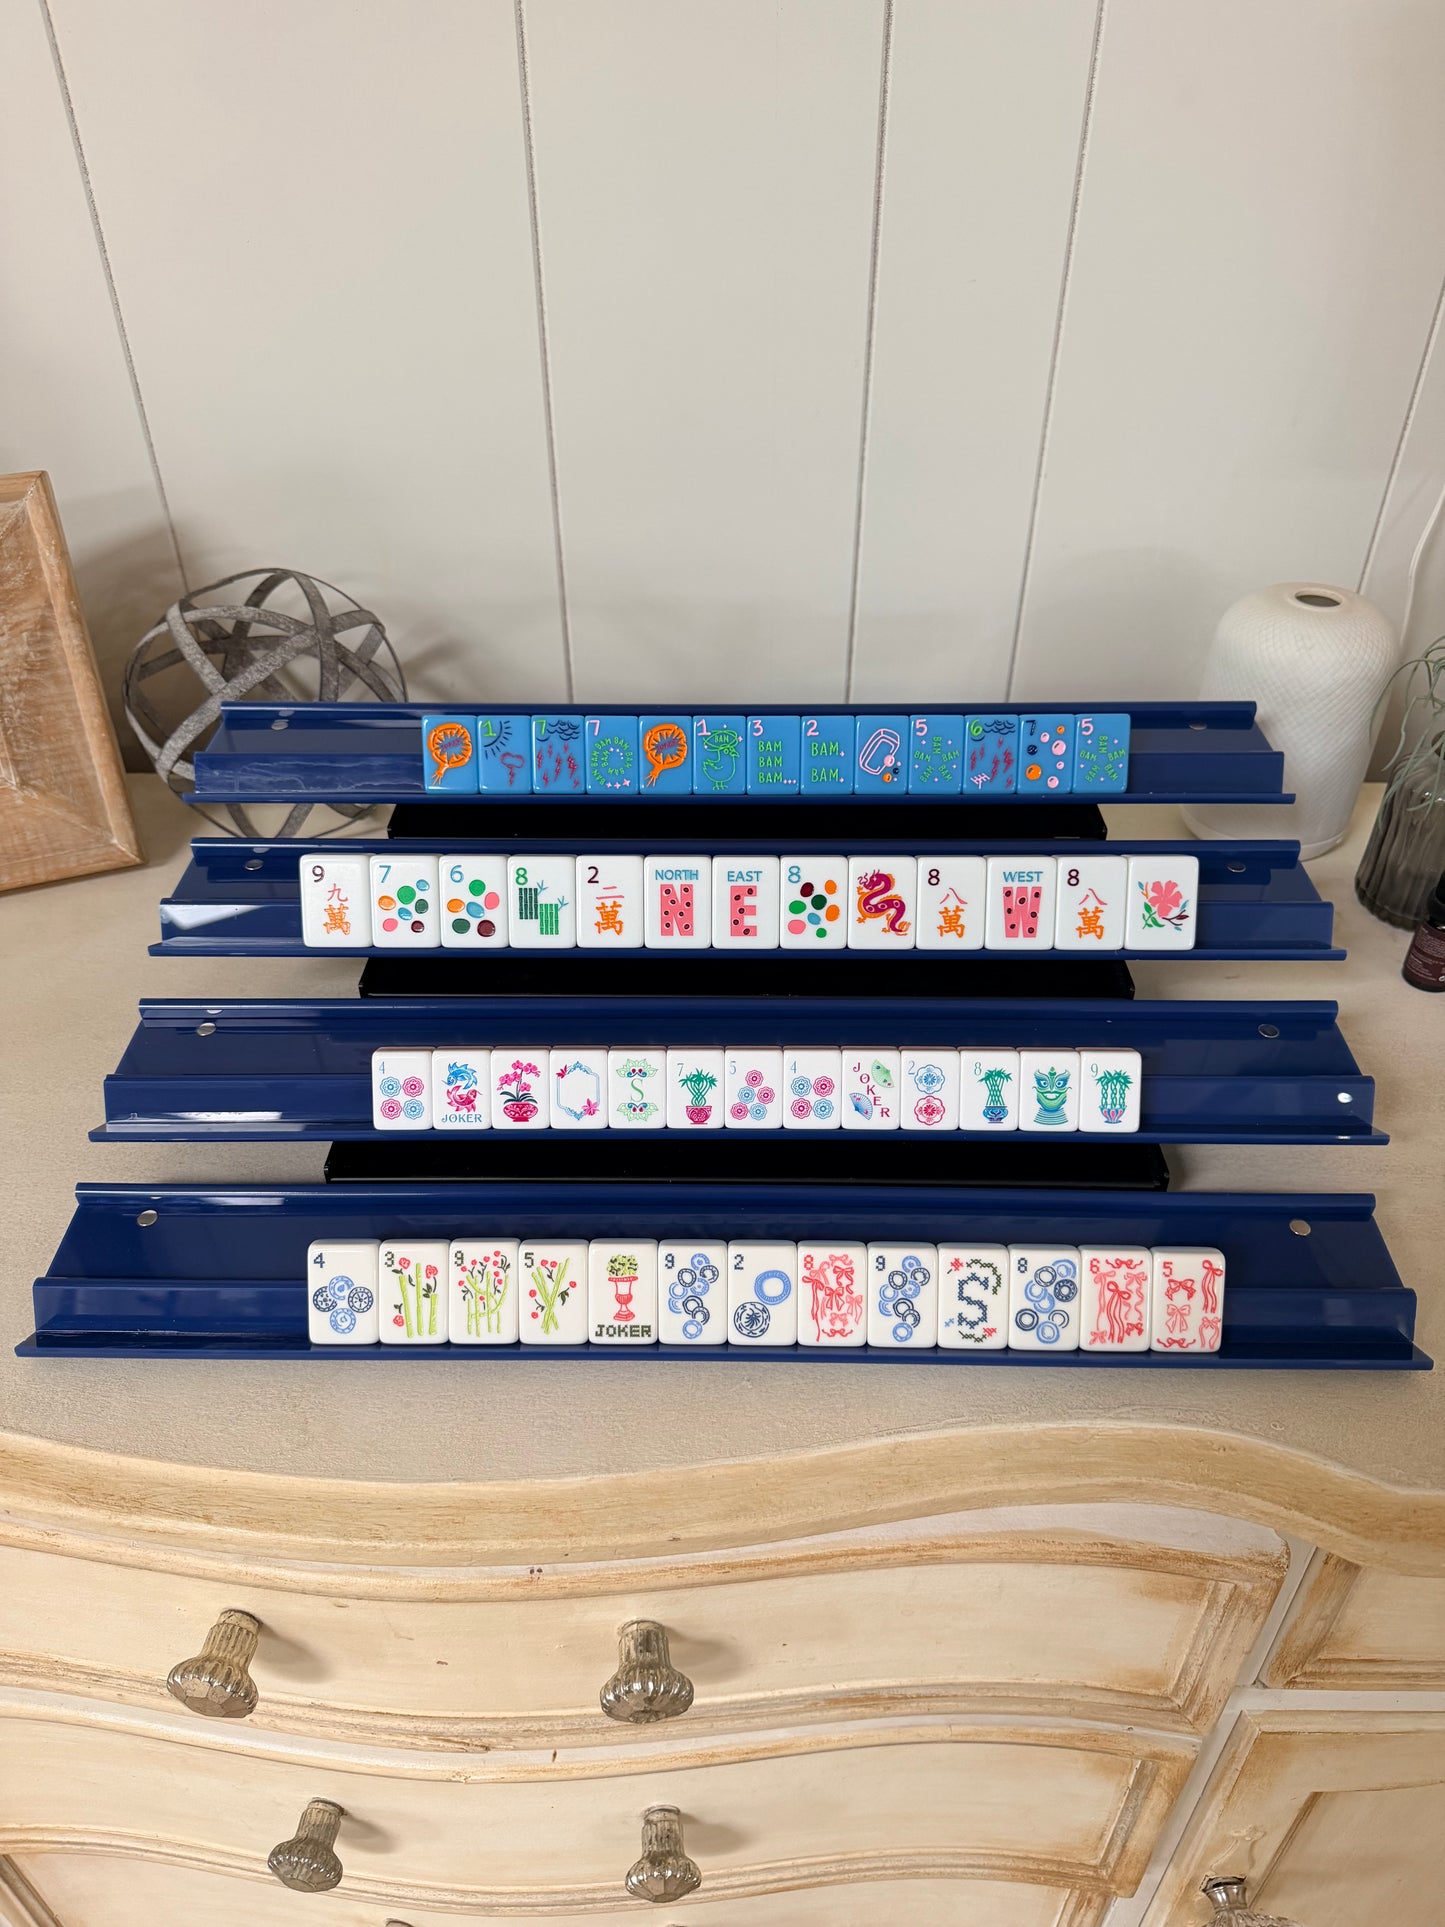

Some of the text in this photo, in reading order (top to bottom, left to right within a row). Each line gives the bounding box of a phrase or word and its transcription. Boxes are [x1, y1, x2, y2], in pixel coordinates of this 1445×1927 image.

[482, 720, 496, 736] 1
[535, 720, 546, 735] 7
[589, 720, 600, 736] 7
[697, 719, 711, 736] 1
[752, 720, 764, 736] 3
[806, 720, 820, 736] 2
[916, 718, 928, 736] 5
[970, 719, 983, 736] 6
[1026, 720, 1036, 736] 7
[1082, 718, 1094, 736] 5
[758, 740, 782, 752] BAM
[759, 756, 782, 768] BAM
[312, 865, 325, 883] 9
[378, 865, 392, 884] 7
[450, 864, 464, 884] 6
[515, 868, 528, 886] 8
[587, 866, 600, 884] 2
[655, 869, 699, 881] NORTH
[727, 870, 762, 882] EAST
[788, 865, 800, 884] 8
[928, 868, 940, 886] 8
[1003, 871, 1043, 882] WEST
[1067, 868, 1080, 886] 8
[660, 884, 694, 936] N
[730, 885, 758, 936] E
[1002, 886, 1042, 938] W
[379, 1060, 386, 1074] 4
[677, 1062, 684, 1077] 7
[729, 1060, 738, 1075] 5
[790, 1060, 798, 1074] 4
[908, 1060, 916, 1075] 2
[974, 1061, 982, 1076] 8
[1090, 1063, 1098, 1078] 9
[630, 1078, 644, 1102] S
[853, 1062, 890, 1118] JOKER
[441, 1114, 482, 1124] JOKER
[314, 1252, 326, 1268] 4
[385, 1251, 394, 1268] 3
[454, 1250, 464, 1267] 9
[524, 1252, 534, 1268] 5
[665, 1253, 675, 1270] 9
[734, 1254, 744, 1270] 2
[804, 1254, 814, 1270] 8
[876, 1256, 886, 1272] 9
[1017, 1257, 1028, 1274] 8
[1088, 1258, 1100, 1274] 6
[1162, 1261, 1174, 1277] 5
[958, 1272, 990, 1330] S
[595, 1324, 652, 1338] JOKER
